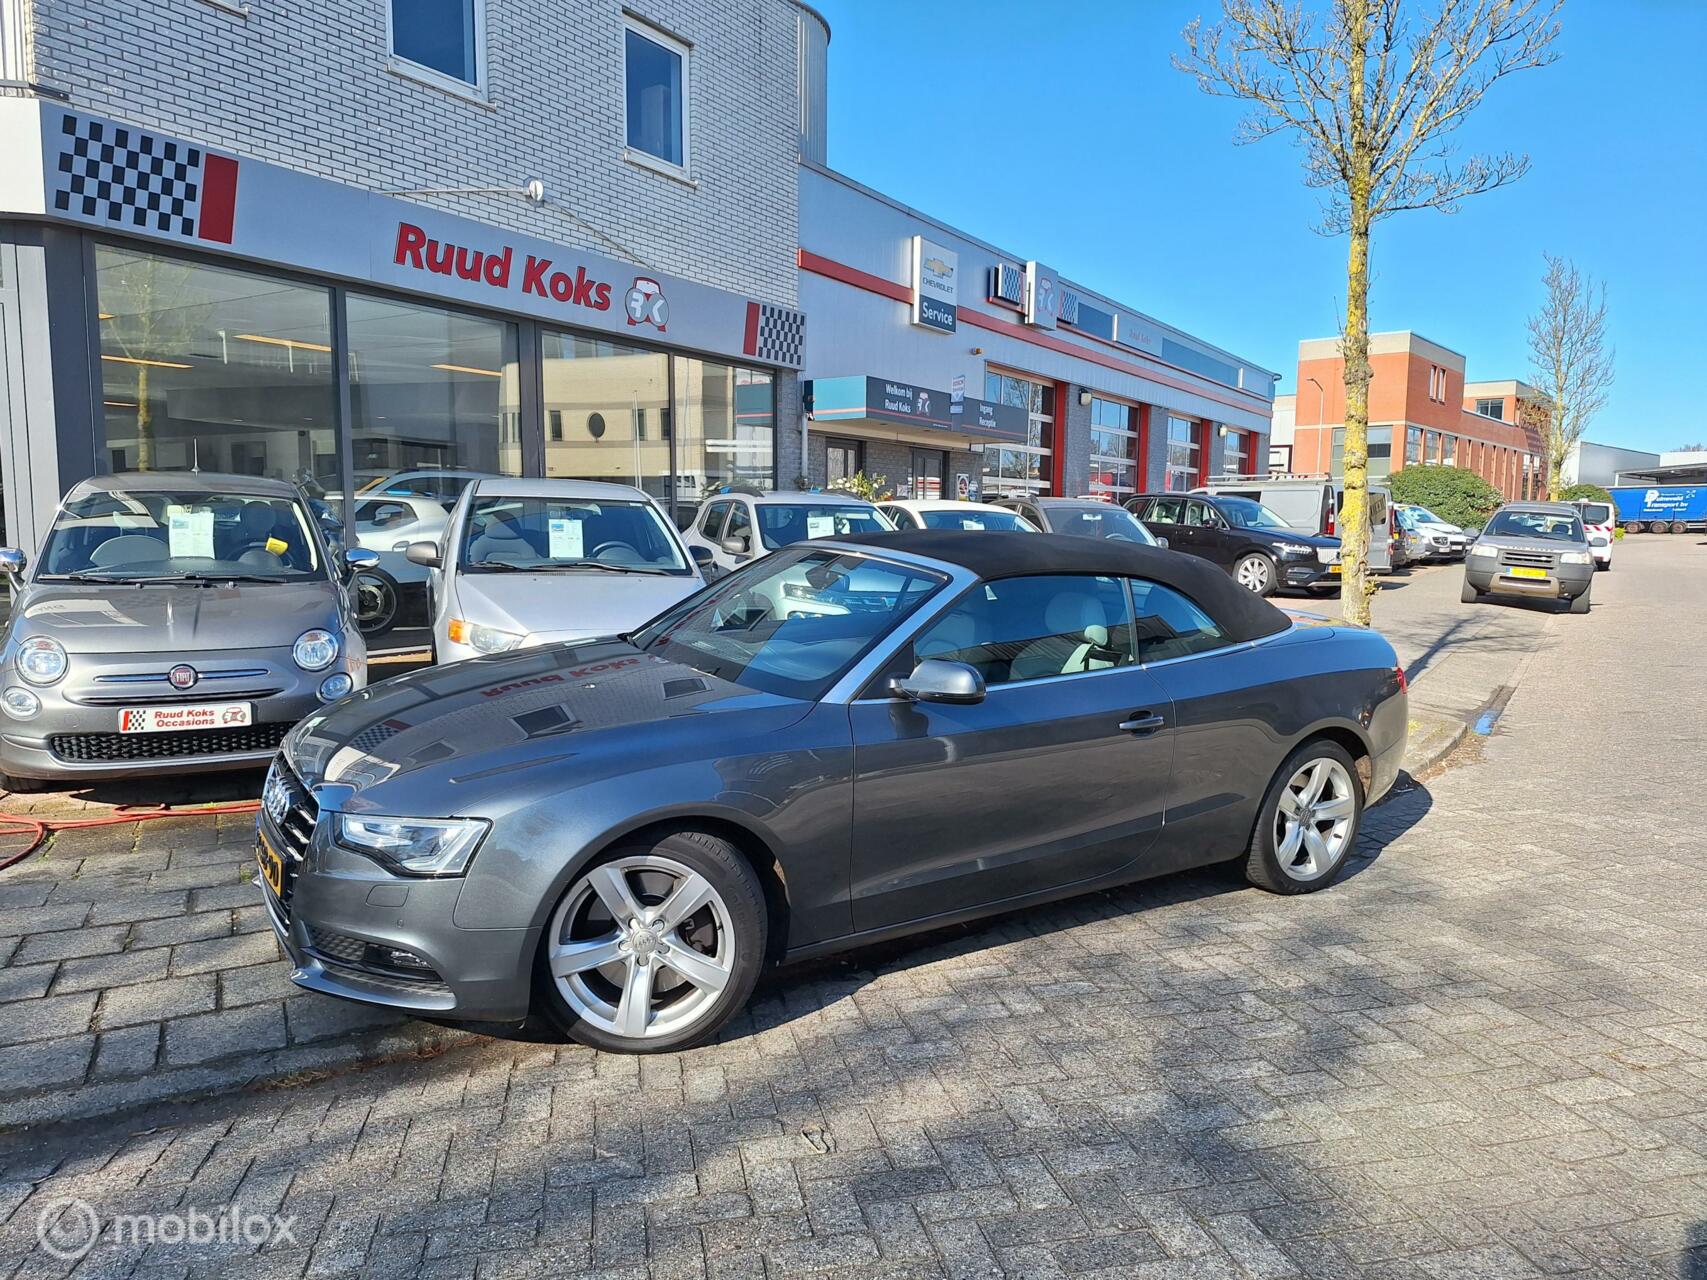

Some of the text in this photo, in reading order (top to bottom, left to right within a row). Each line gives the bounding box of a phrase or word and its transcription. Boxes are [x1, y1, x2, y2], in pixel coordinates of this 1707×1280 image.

[394, 222, 612, 312] Ruud Koks
[922, 276, 954, 294] CHEVROLET
[922, 301, 953, 326] Service
[886, 384, 905, 398] Welkom
[885, 399, 911, 413] Ruud Koks
[155, 709, 215, 719] Ruud Koks
[157, 719, 215, 727] Occasions
